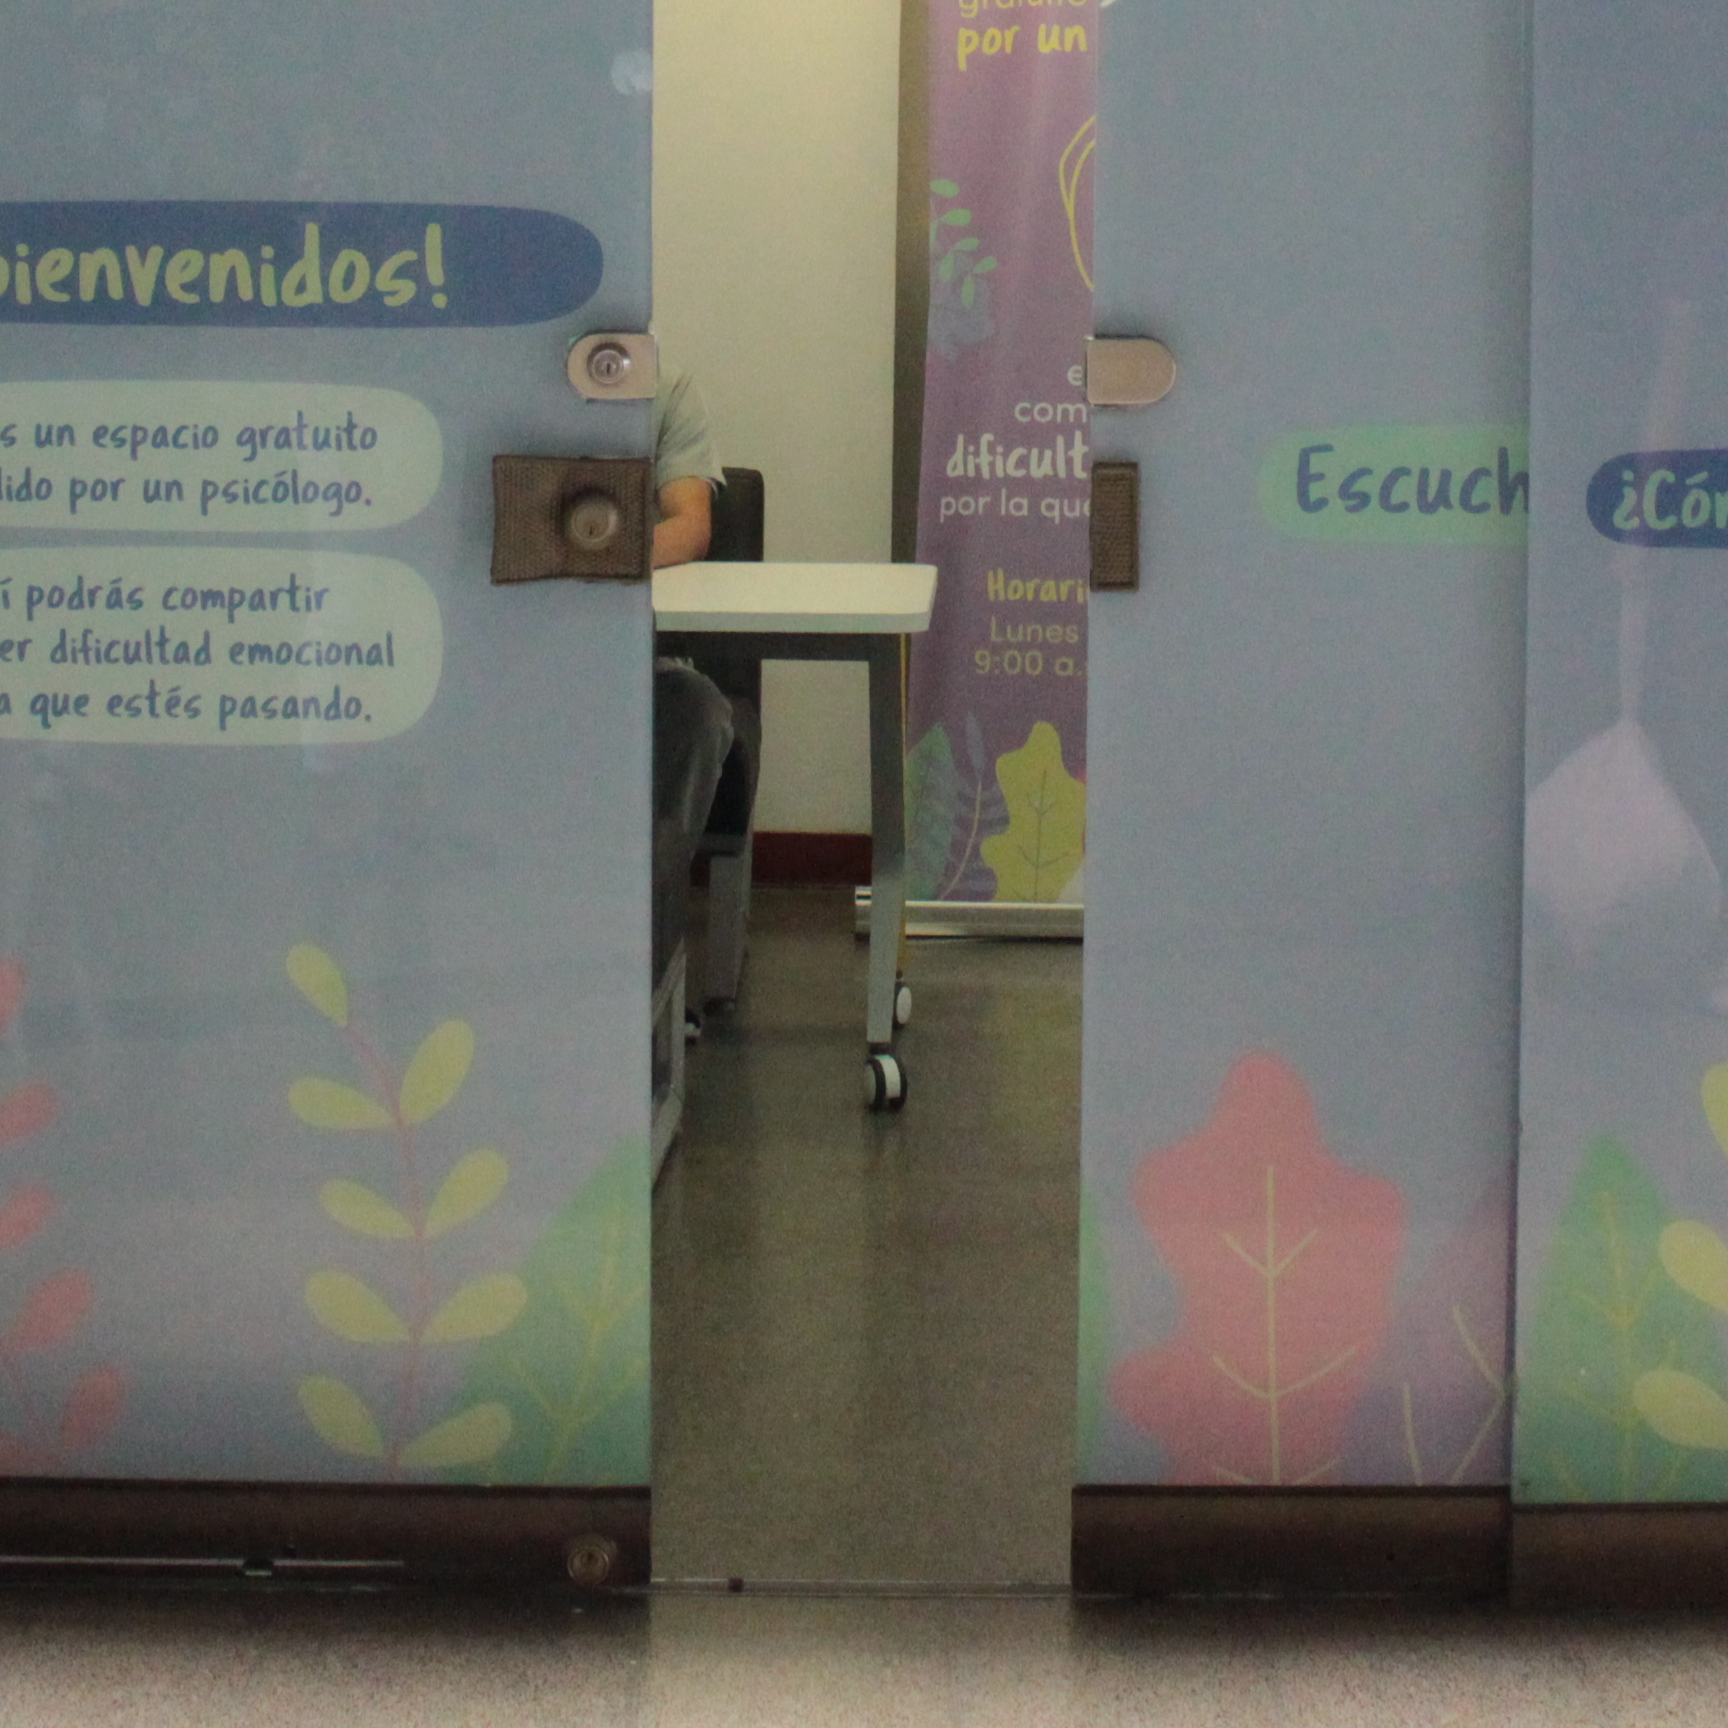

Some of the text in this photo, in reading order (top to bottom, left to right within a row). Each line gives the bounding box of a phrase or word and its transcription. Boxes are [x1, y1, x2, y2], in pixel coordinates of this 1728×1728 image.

[957, 24, 1088, 71] por un
[34, 423, 76, 448] un
[91, 423, 220, 462] espacio
[235, 410, 378, 463] gratuito
[69, 476, 126, 515] por
[142, 477, 184, 504] un
[200, 468, 372, 517] psicólogo.
[940, 496, 991, 523] por
[1000, 487, 1028, 516] la
[26, 575, 145, 622] podrás
[161, 572, 330, 624] compartir
[987, 567, 1089, 604] Horari
[49, 625, 212, 666] dificultad
[228, 630, 395, 667] emocional
[990, 616, 1079, 644] Lunes
[974, 649, 1043, 676] 9:00
[29, 692, 91, 729] que
[106, 678, 202, 720] estés
[219, 683, 373, 731] pasando.
